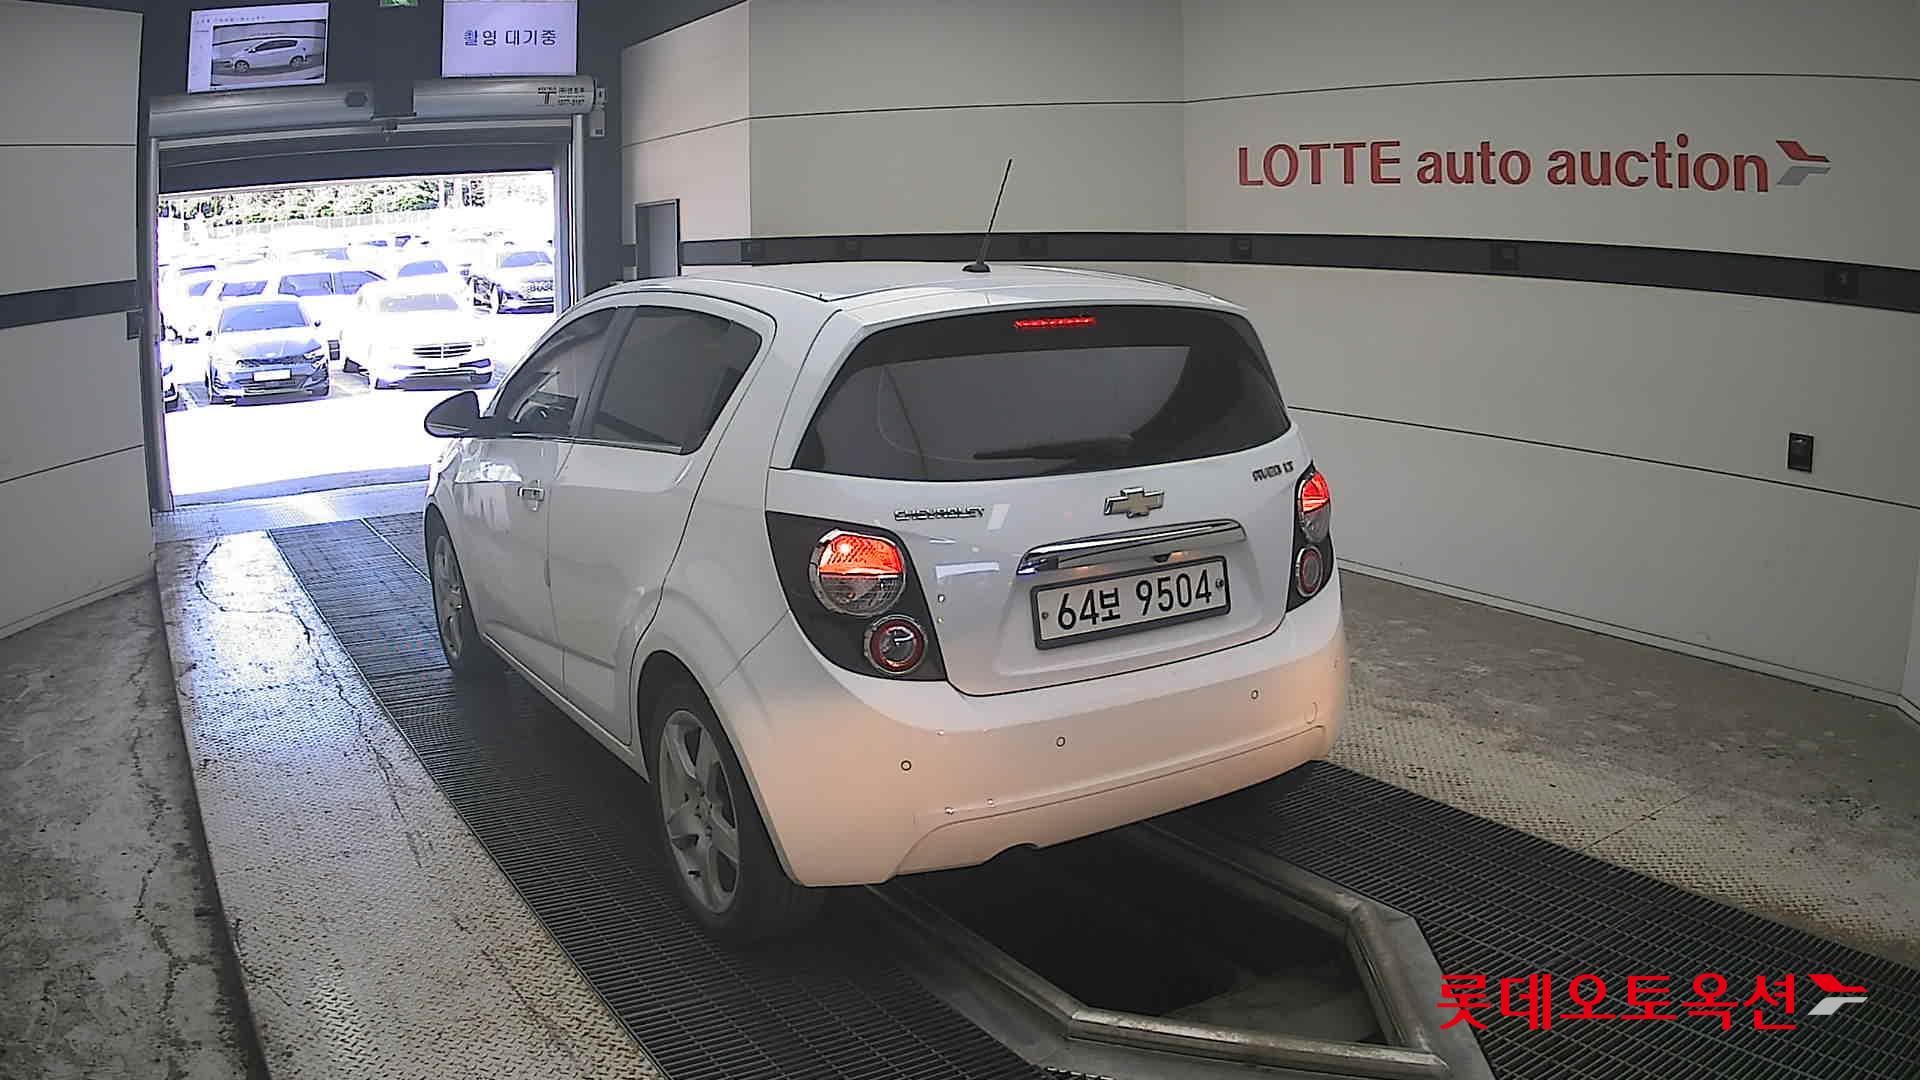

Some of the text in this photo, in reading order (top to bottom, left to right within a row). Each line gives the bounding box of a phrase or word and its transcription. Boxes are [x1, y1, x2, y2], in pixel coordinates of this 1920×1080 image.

[505, 29, 556, 46] 대기중
[1238, 133, 1769, 193] LOTTE auto auction
[1056, 568, 1213, 631] 64보 9504
